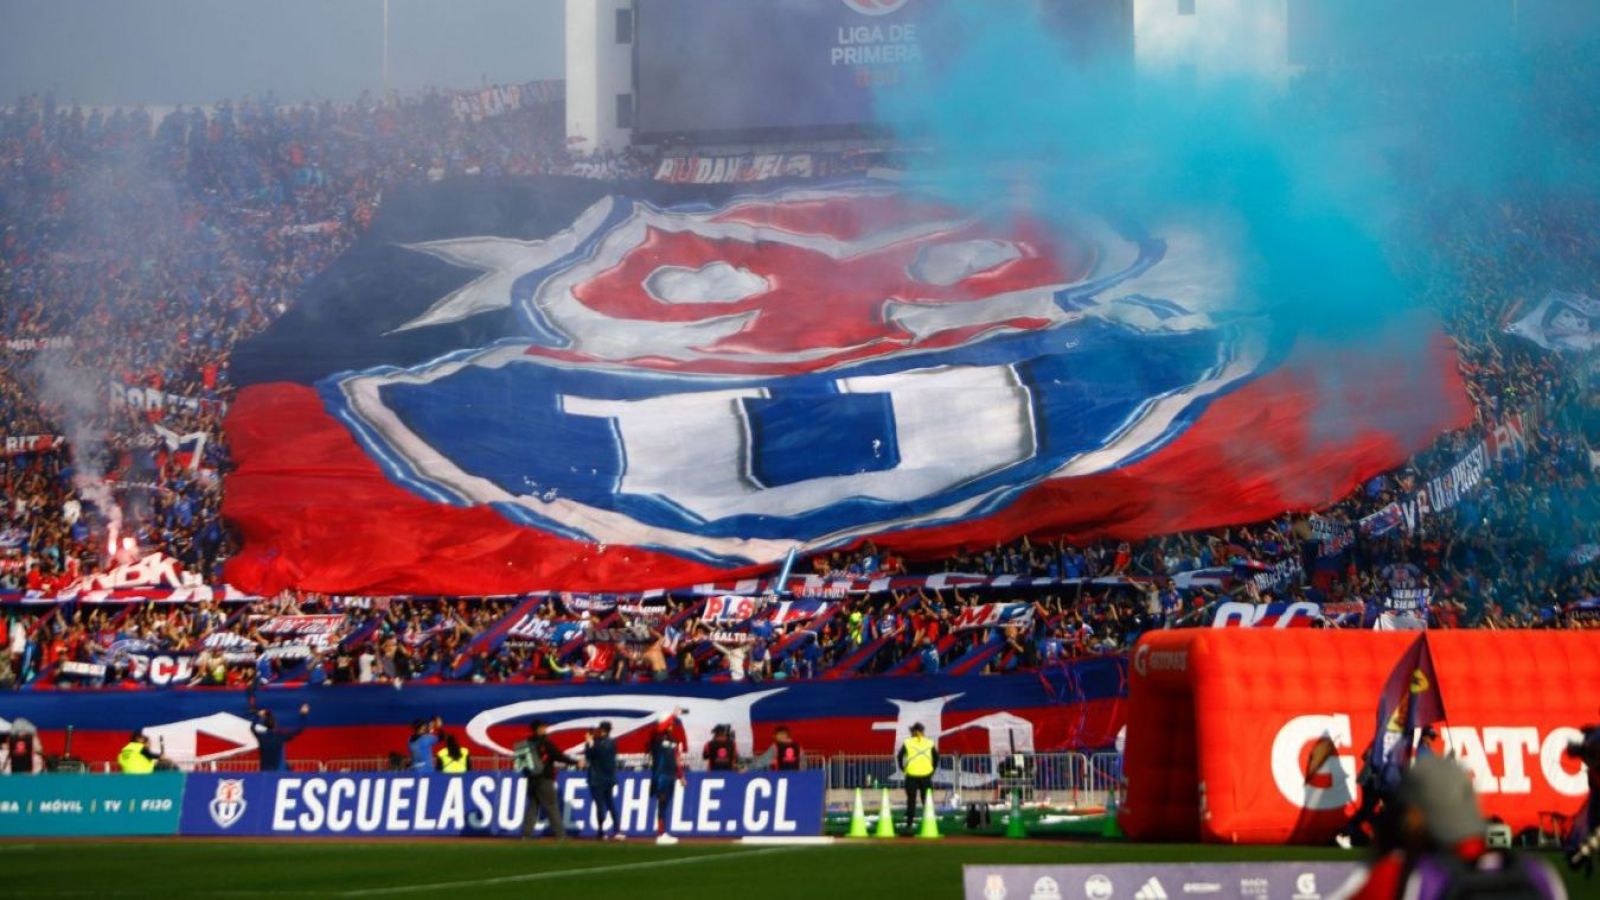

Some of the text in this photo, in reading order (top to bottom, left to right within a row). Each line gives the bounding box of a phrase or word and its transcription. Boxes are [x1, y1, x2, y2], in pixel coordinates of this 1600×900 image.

[838, 24, 917, 44] LIGA DE
[831, 45, 925, 65] PRIMERA
[39, 799, 83, 813] MÓVIL
[103, 800, 122, 812] TV
